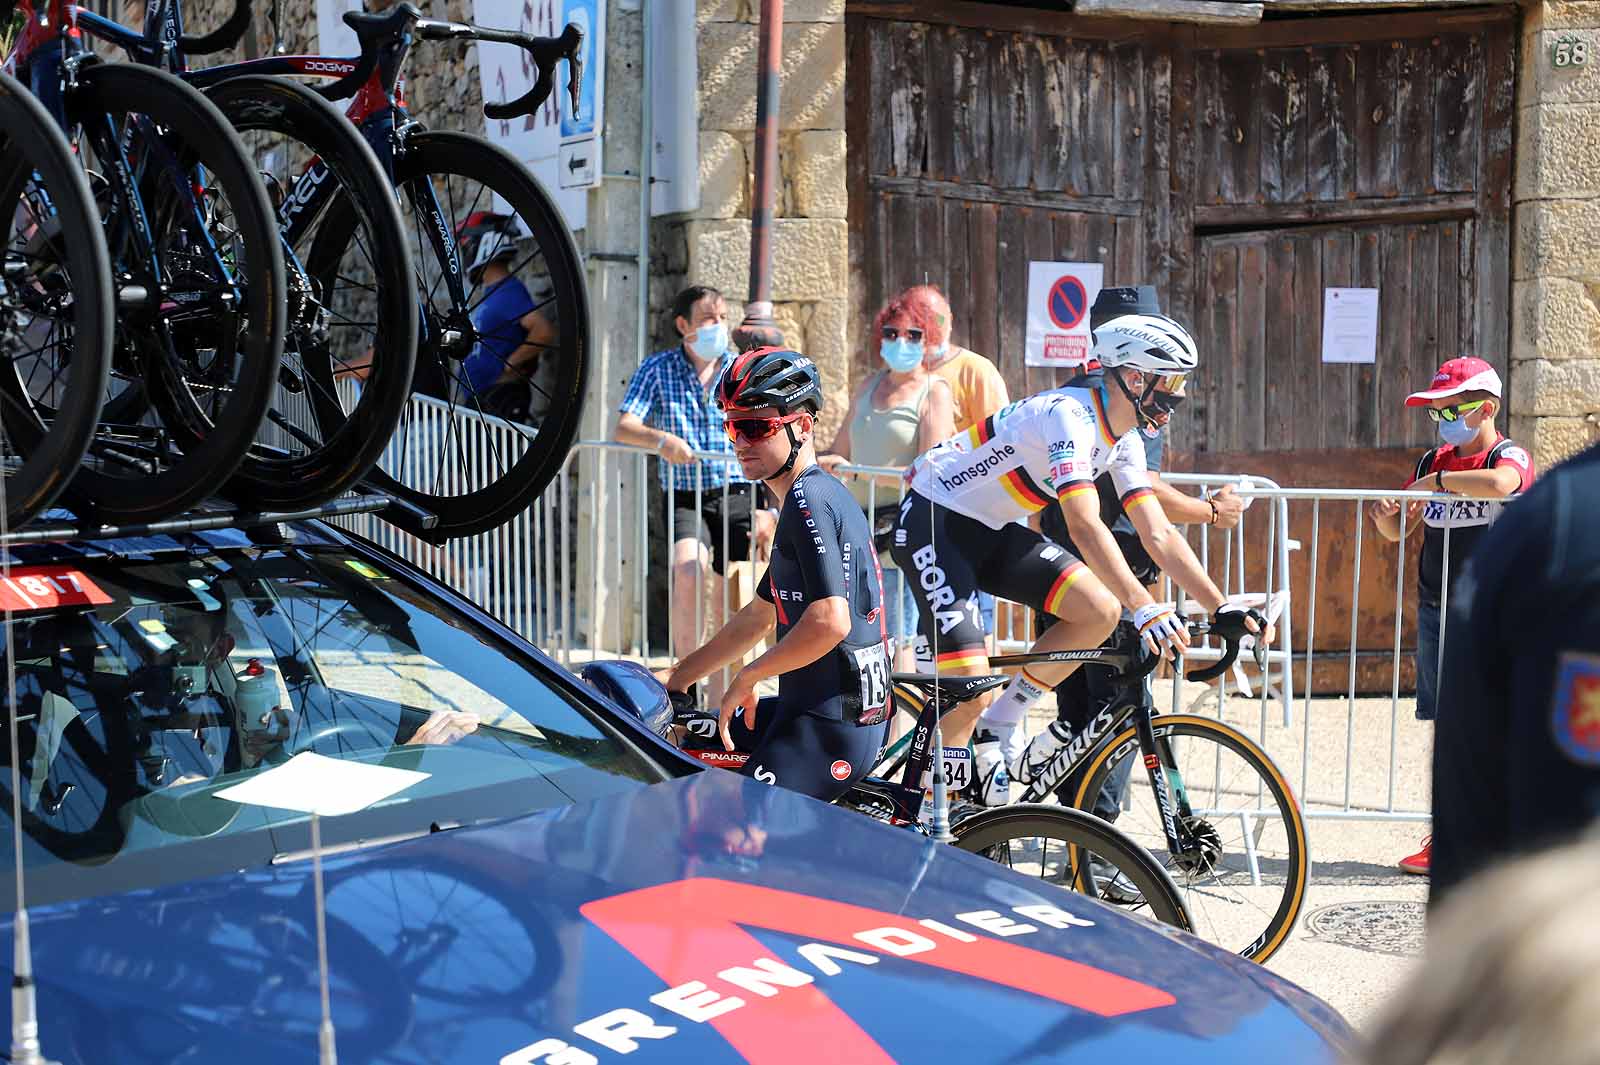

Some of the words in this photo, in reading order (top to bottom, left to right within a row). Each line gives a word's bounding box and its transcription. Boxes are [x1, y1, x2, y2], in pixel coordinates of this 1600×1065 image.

[1556, 42, 1588, 65] 58
[1113, 327, 1178, 354] SPECIALIZED
[938, 445, 1016, 492] hansgrohe
[19, 573, 84, 597] 817
[911, 544, 965, 636] BORA
[1048, 650, 1103, 661] SPECIALIZED
[911, 725, 929, 761] INEOS
[943, 762, 967, 787] 34
